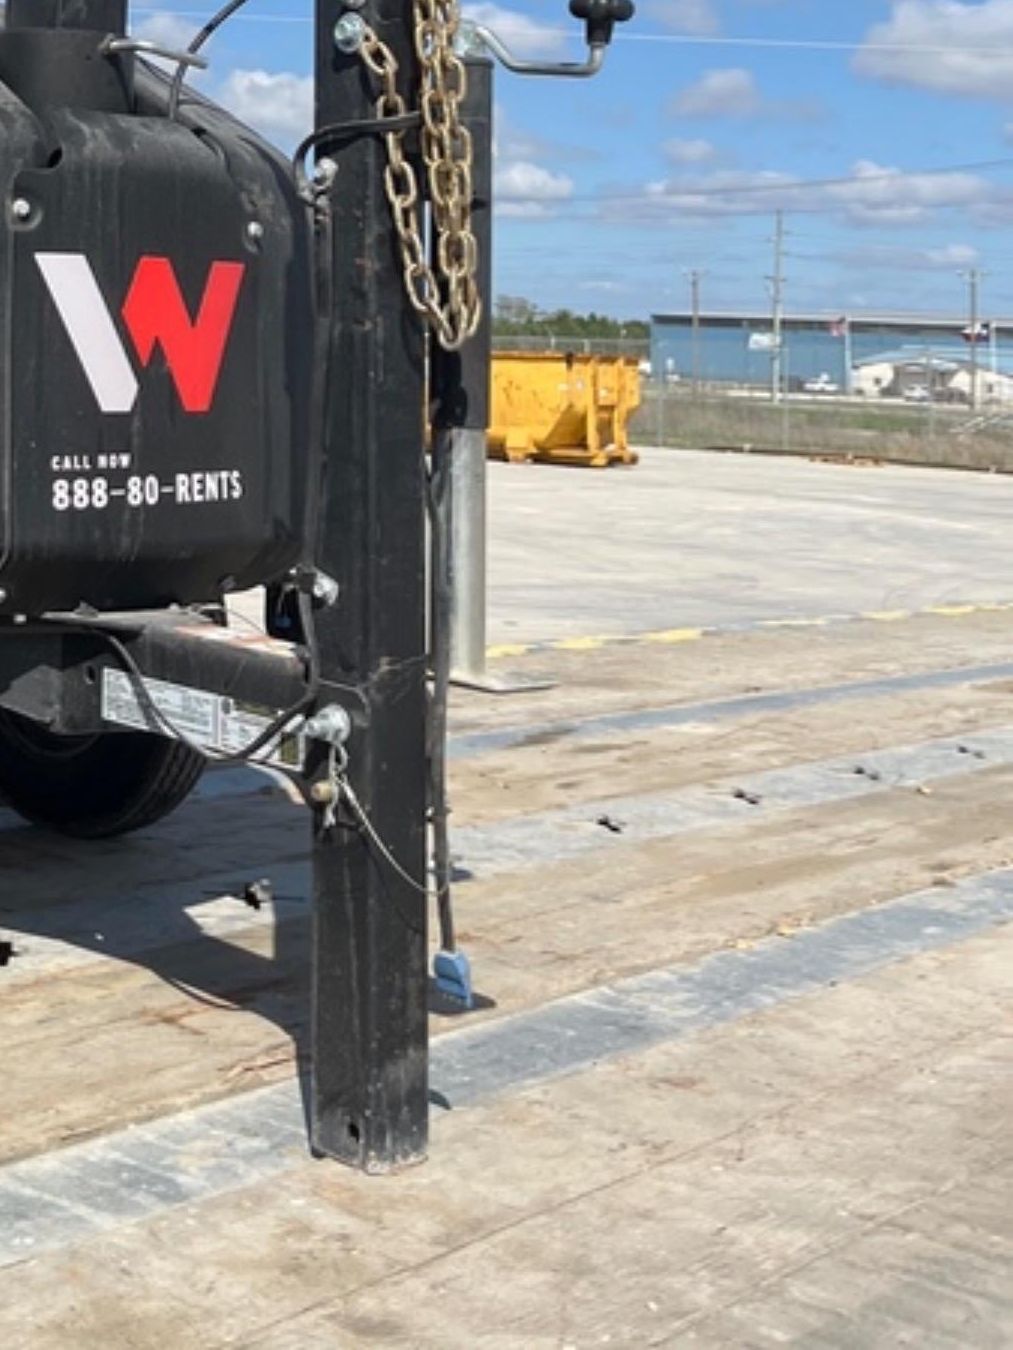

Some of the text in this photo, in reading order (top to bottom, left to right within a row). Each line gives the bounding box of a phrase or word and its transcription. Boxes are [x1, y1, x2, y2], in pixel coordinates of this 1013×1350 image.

[50, 452, 132, 472] CALL NOW
[51, 470, 243, 511] 888-80-RENTS
